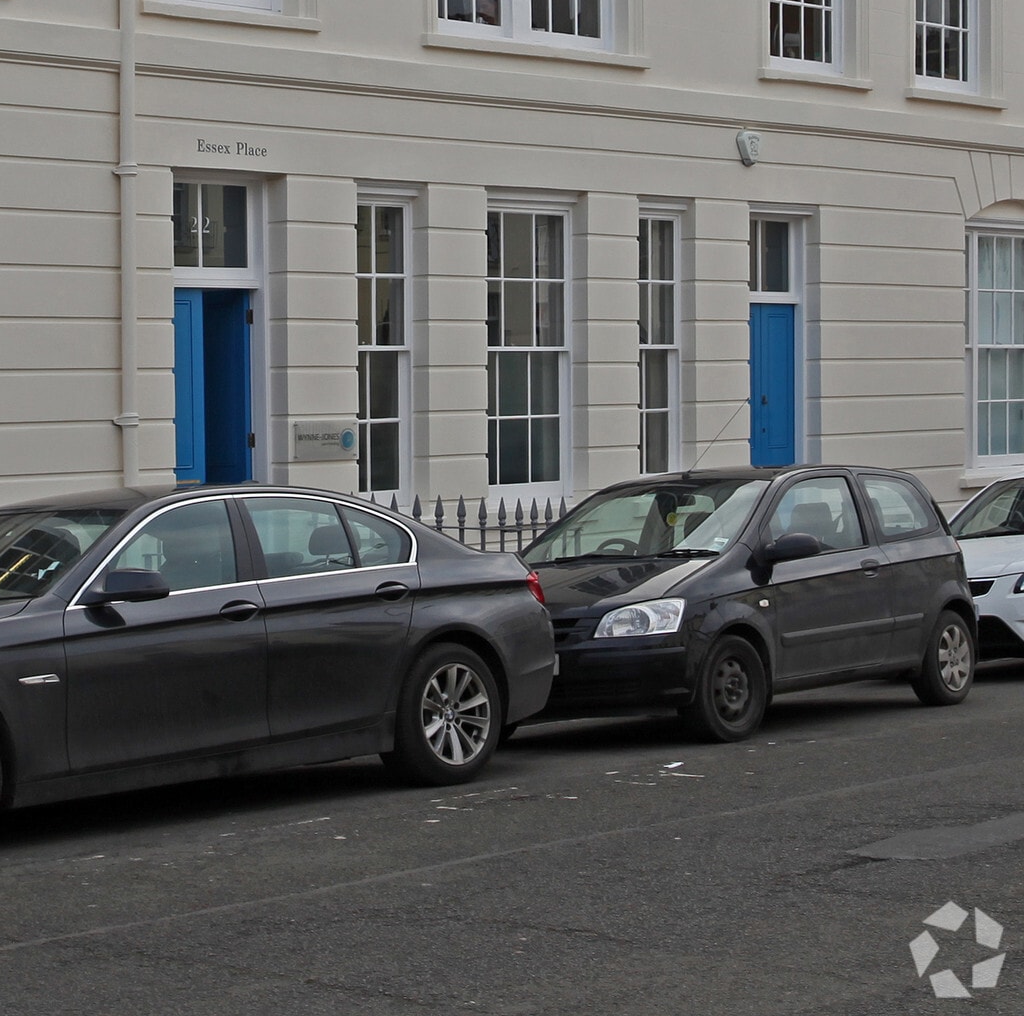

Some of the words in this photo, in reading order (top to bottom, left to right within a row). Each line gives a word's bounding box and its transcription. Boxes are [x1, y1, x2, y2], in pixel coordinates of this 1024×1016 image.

[197, 139, 230, 154] Essex
[236, 142, 267, 157] Place
[191, 217, 210, 233] 22
